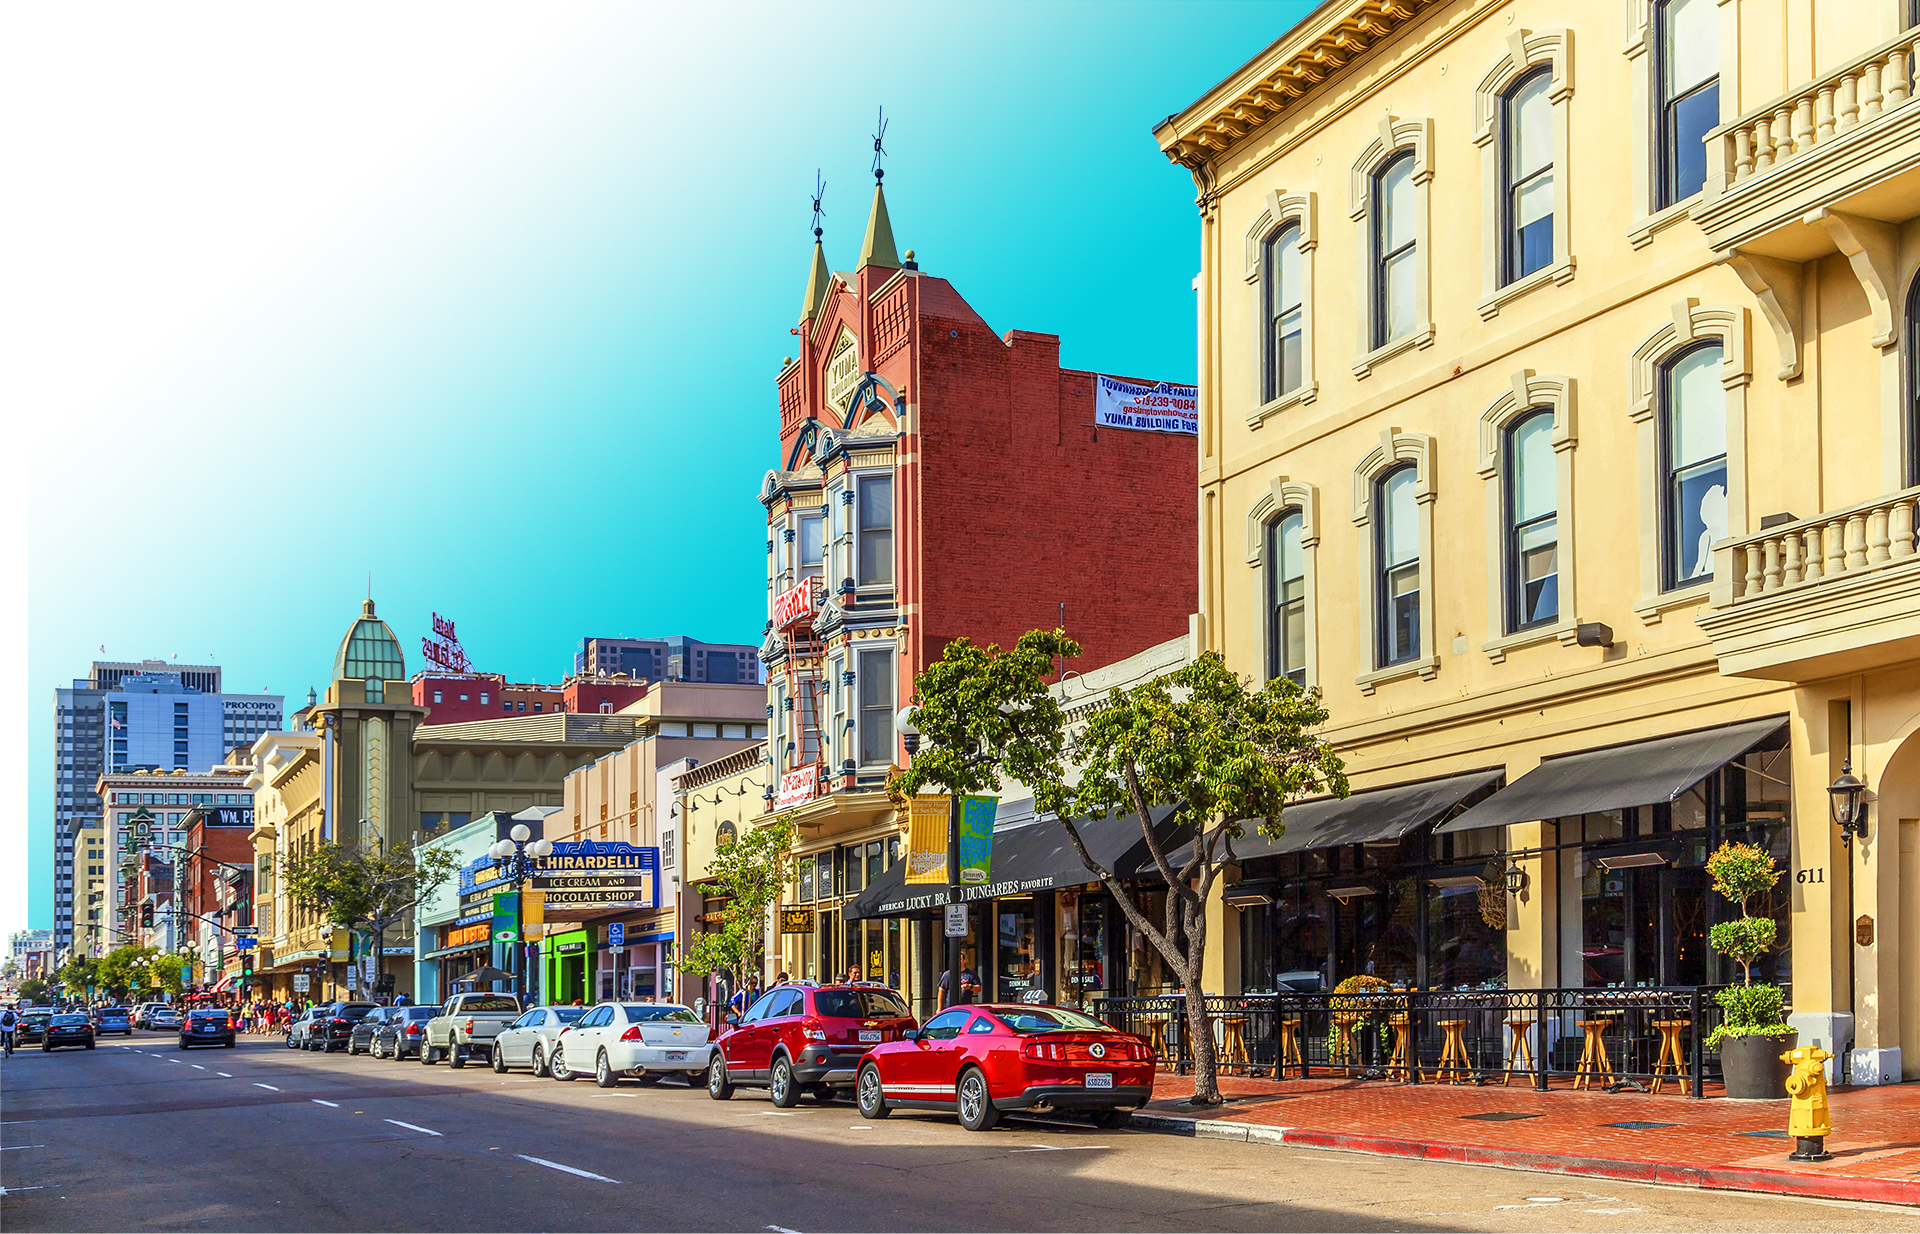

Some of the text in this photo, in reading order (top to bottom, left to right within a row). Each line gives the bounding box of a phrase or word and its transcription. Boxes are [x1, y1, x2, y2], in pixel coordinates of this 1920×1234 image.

[832, 350, 858, 384] YUMA
[1104, 412, 1198, 432] YUMA BUILDING FOR
[225, 701, 276, 710] PROCOPIO
[1796, 867, 1825, 884] 611
[549, 877, 626, 888] ICE CREAM AND
[545, 892, 602, 902] HOCOLATE
[605, 891, 635, 901] SHOP
[878, 900, 905, 912] AMERICA'S
[905, 894, 932, 911] LUCKY
[966, 880, 1019, 901] DUNGAREES
[1020, 876, 1054, 890] FAVORITE
[954, 905, 959, 913] 3
[1021, 979, 1030, 987] SALE
